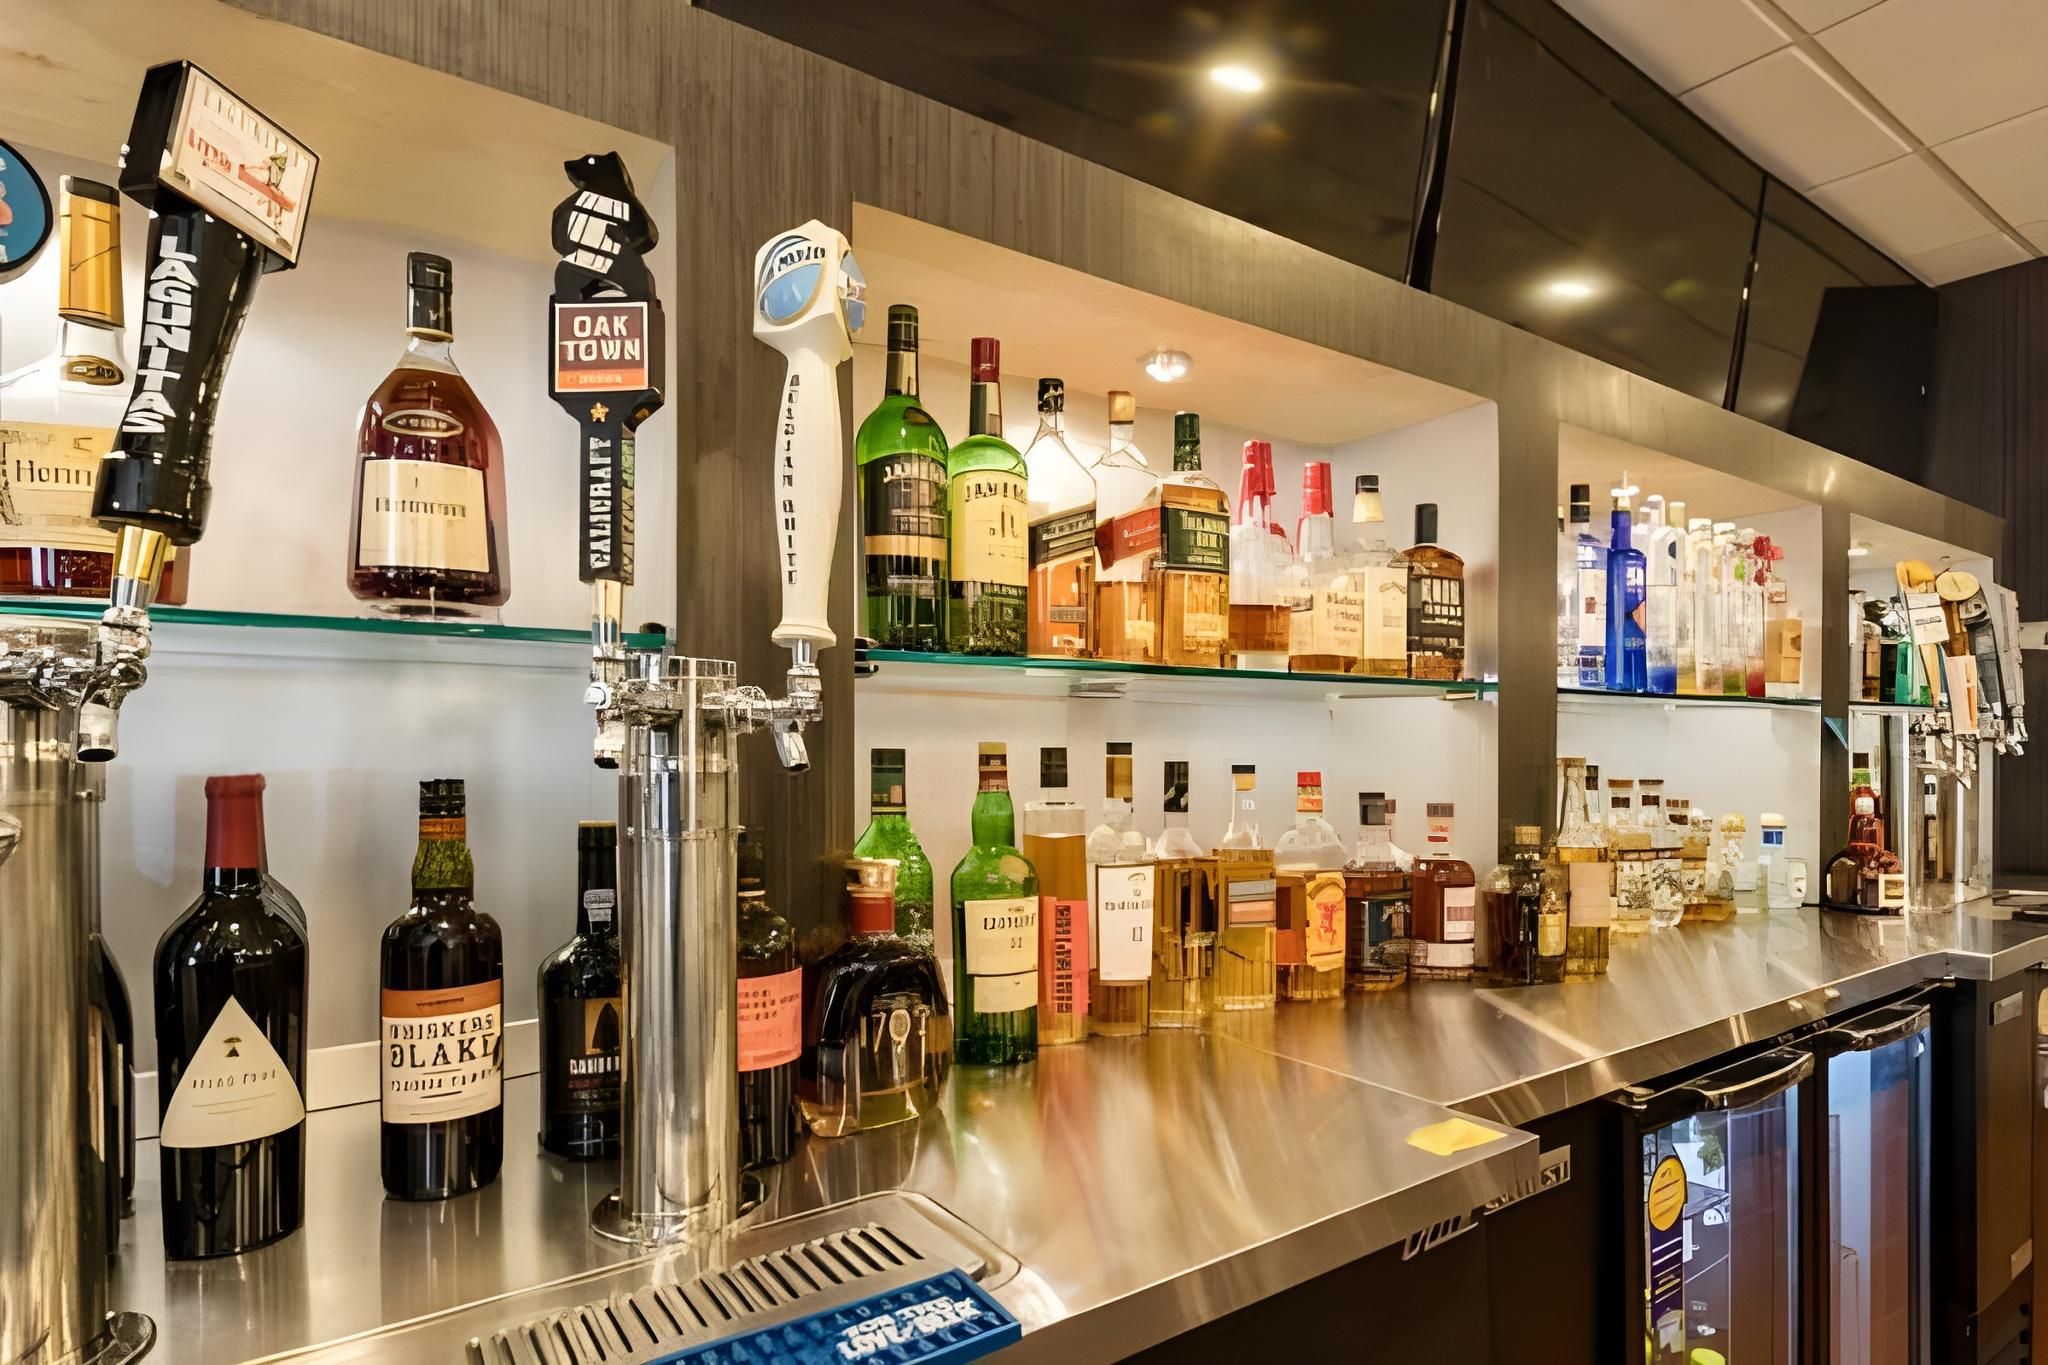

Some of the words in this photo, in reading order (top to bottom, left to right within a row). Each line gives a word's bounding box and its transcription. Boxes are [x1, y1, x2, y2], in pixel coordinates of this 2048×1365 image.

[122, 235, 199, 433] LAGUNITAS
[573, 315, 629, 338] OAK
[559, 338, 641, 362] TOWN
